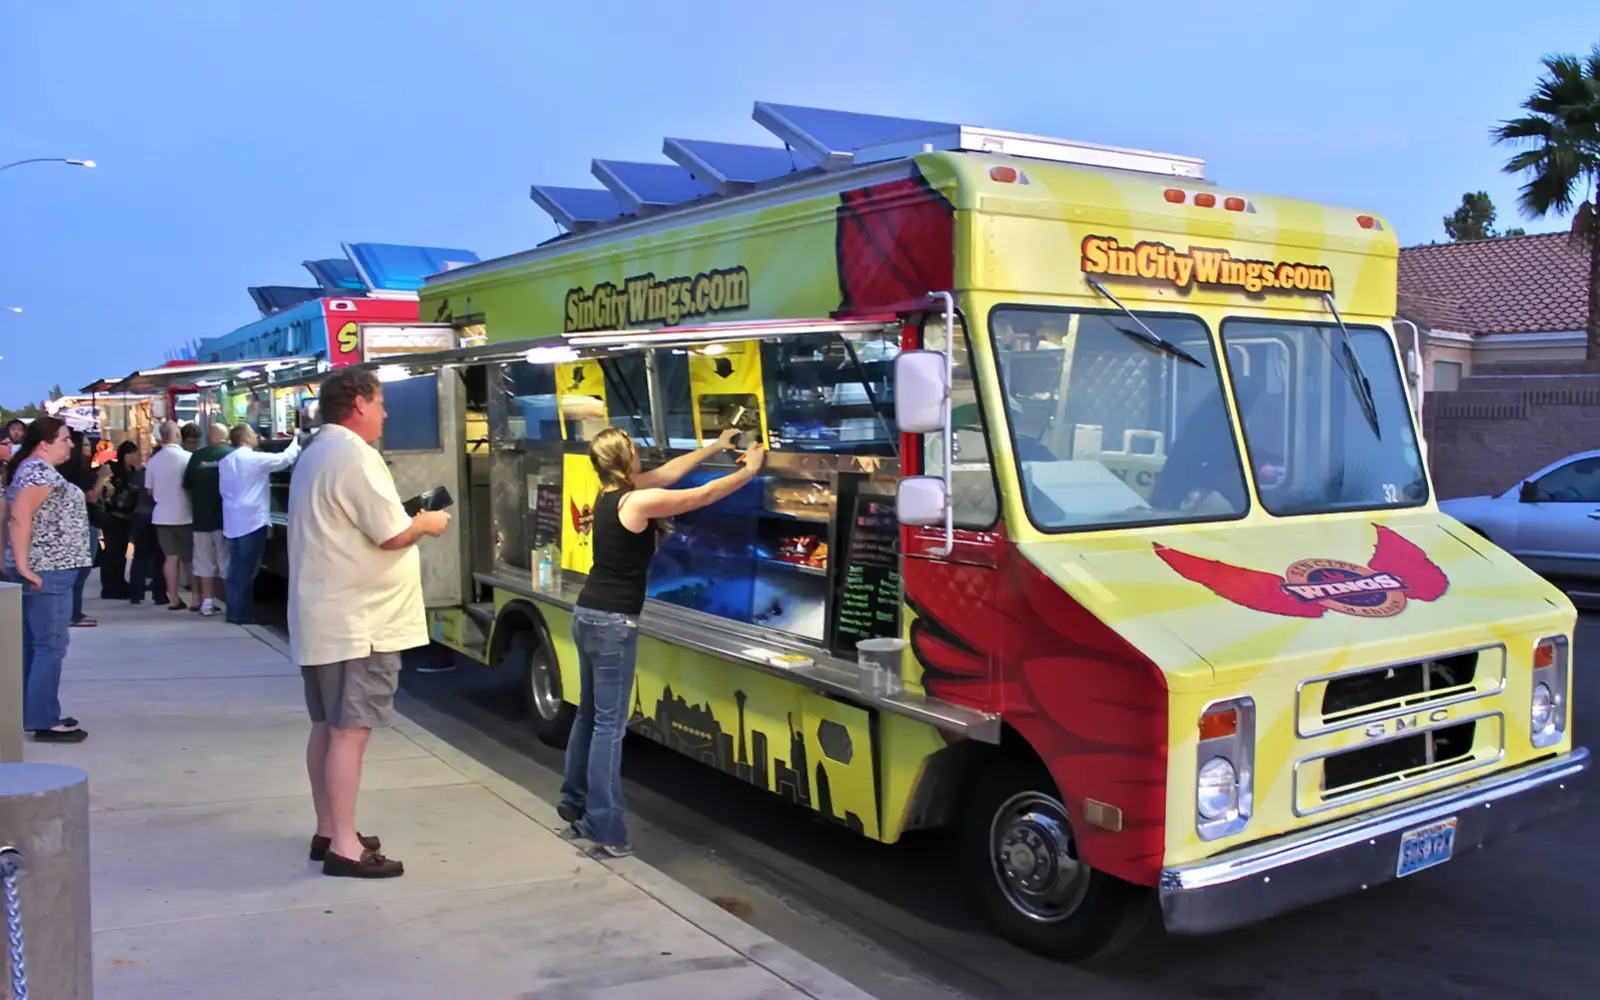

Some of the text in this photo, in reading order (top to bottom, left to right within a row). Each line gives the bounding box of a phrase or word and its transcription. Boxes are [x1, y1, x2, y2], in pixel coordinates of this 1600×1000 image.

[1082, 236, 1333, 292] SinCityWings.com
[565, 267, 749, 331] SinCityWings.com
[1286, 574, 1401, 600] WINGS
